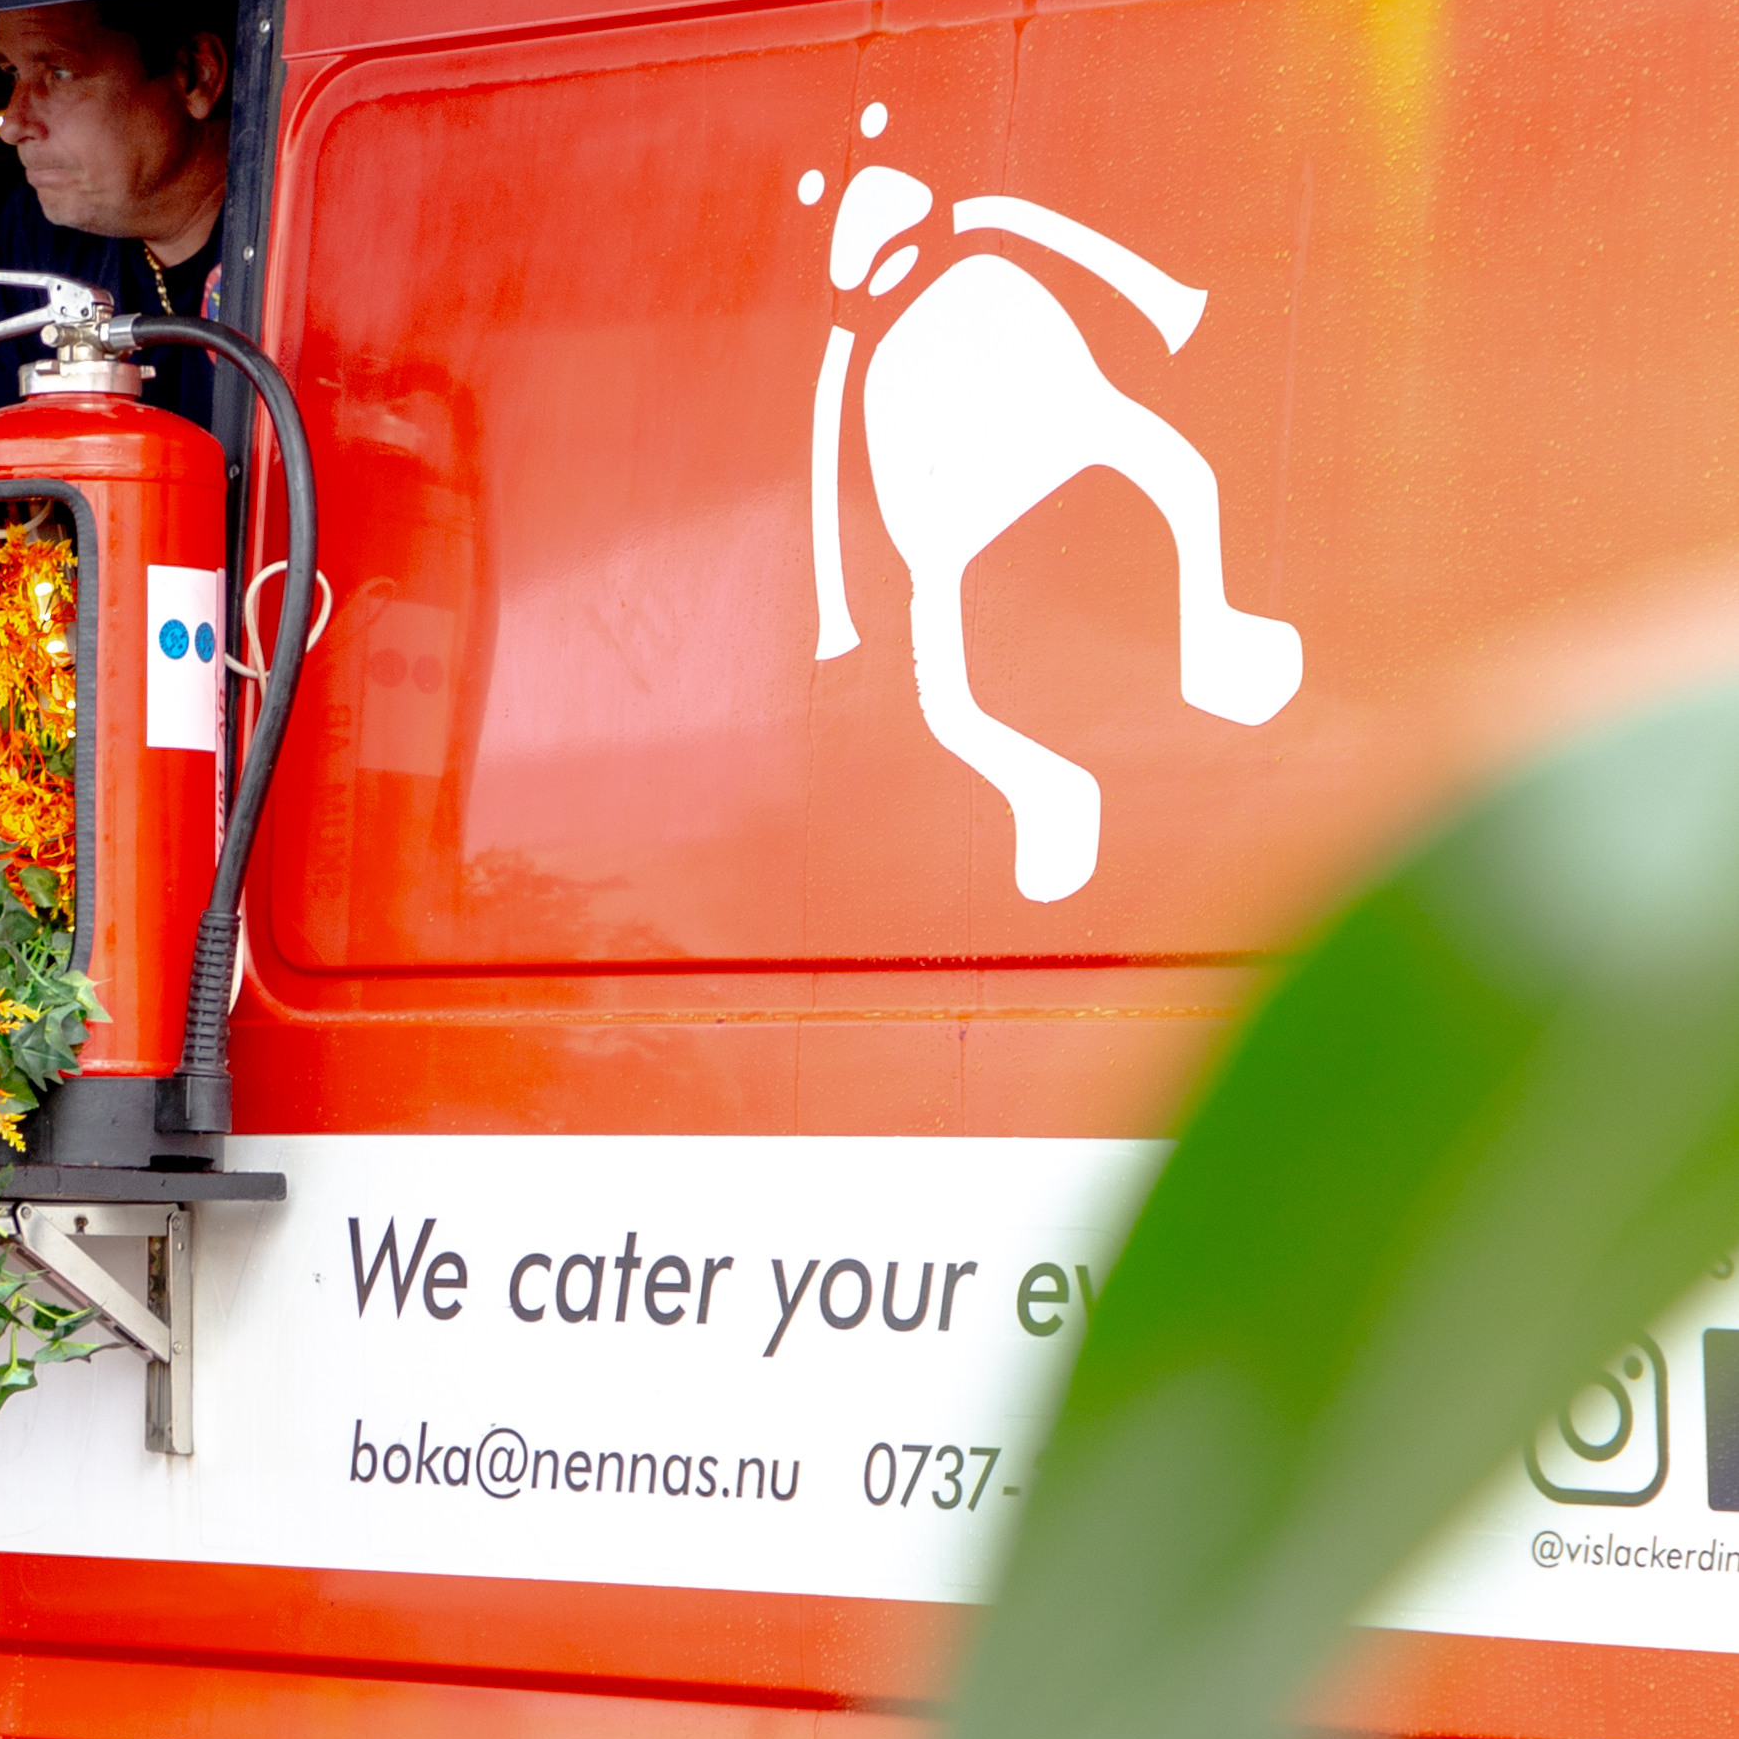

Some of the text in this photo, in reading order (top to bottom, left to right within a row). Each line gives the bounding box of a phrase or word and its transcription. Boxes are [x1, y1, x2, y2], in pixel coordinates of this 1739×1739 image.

[347, 1215, 468, 1322] We
[507, 1231, 734, 1326] cater
[762, 1257, 979, 1359] your
[348, 1418, 802, 1501] boka@nennas.nu
